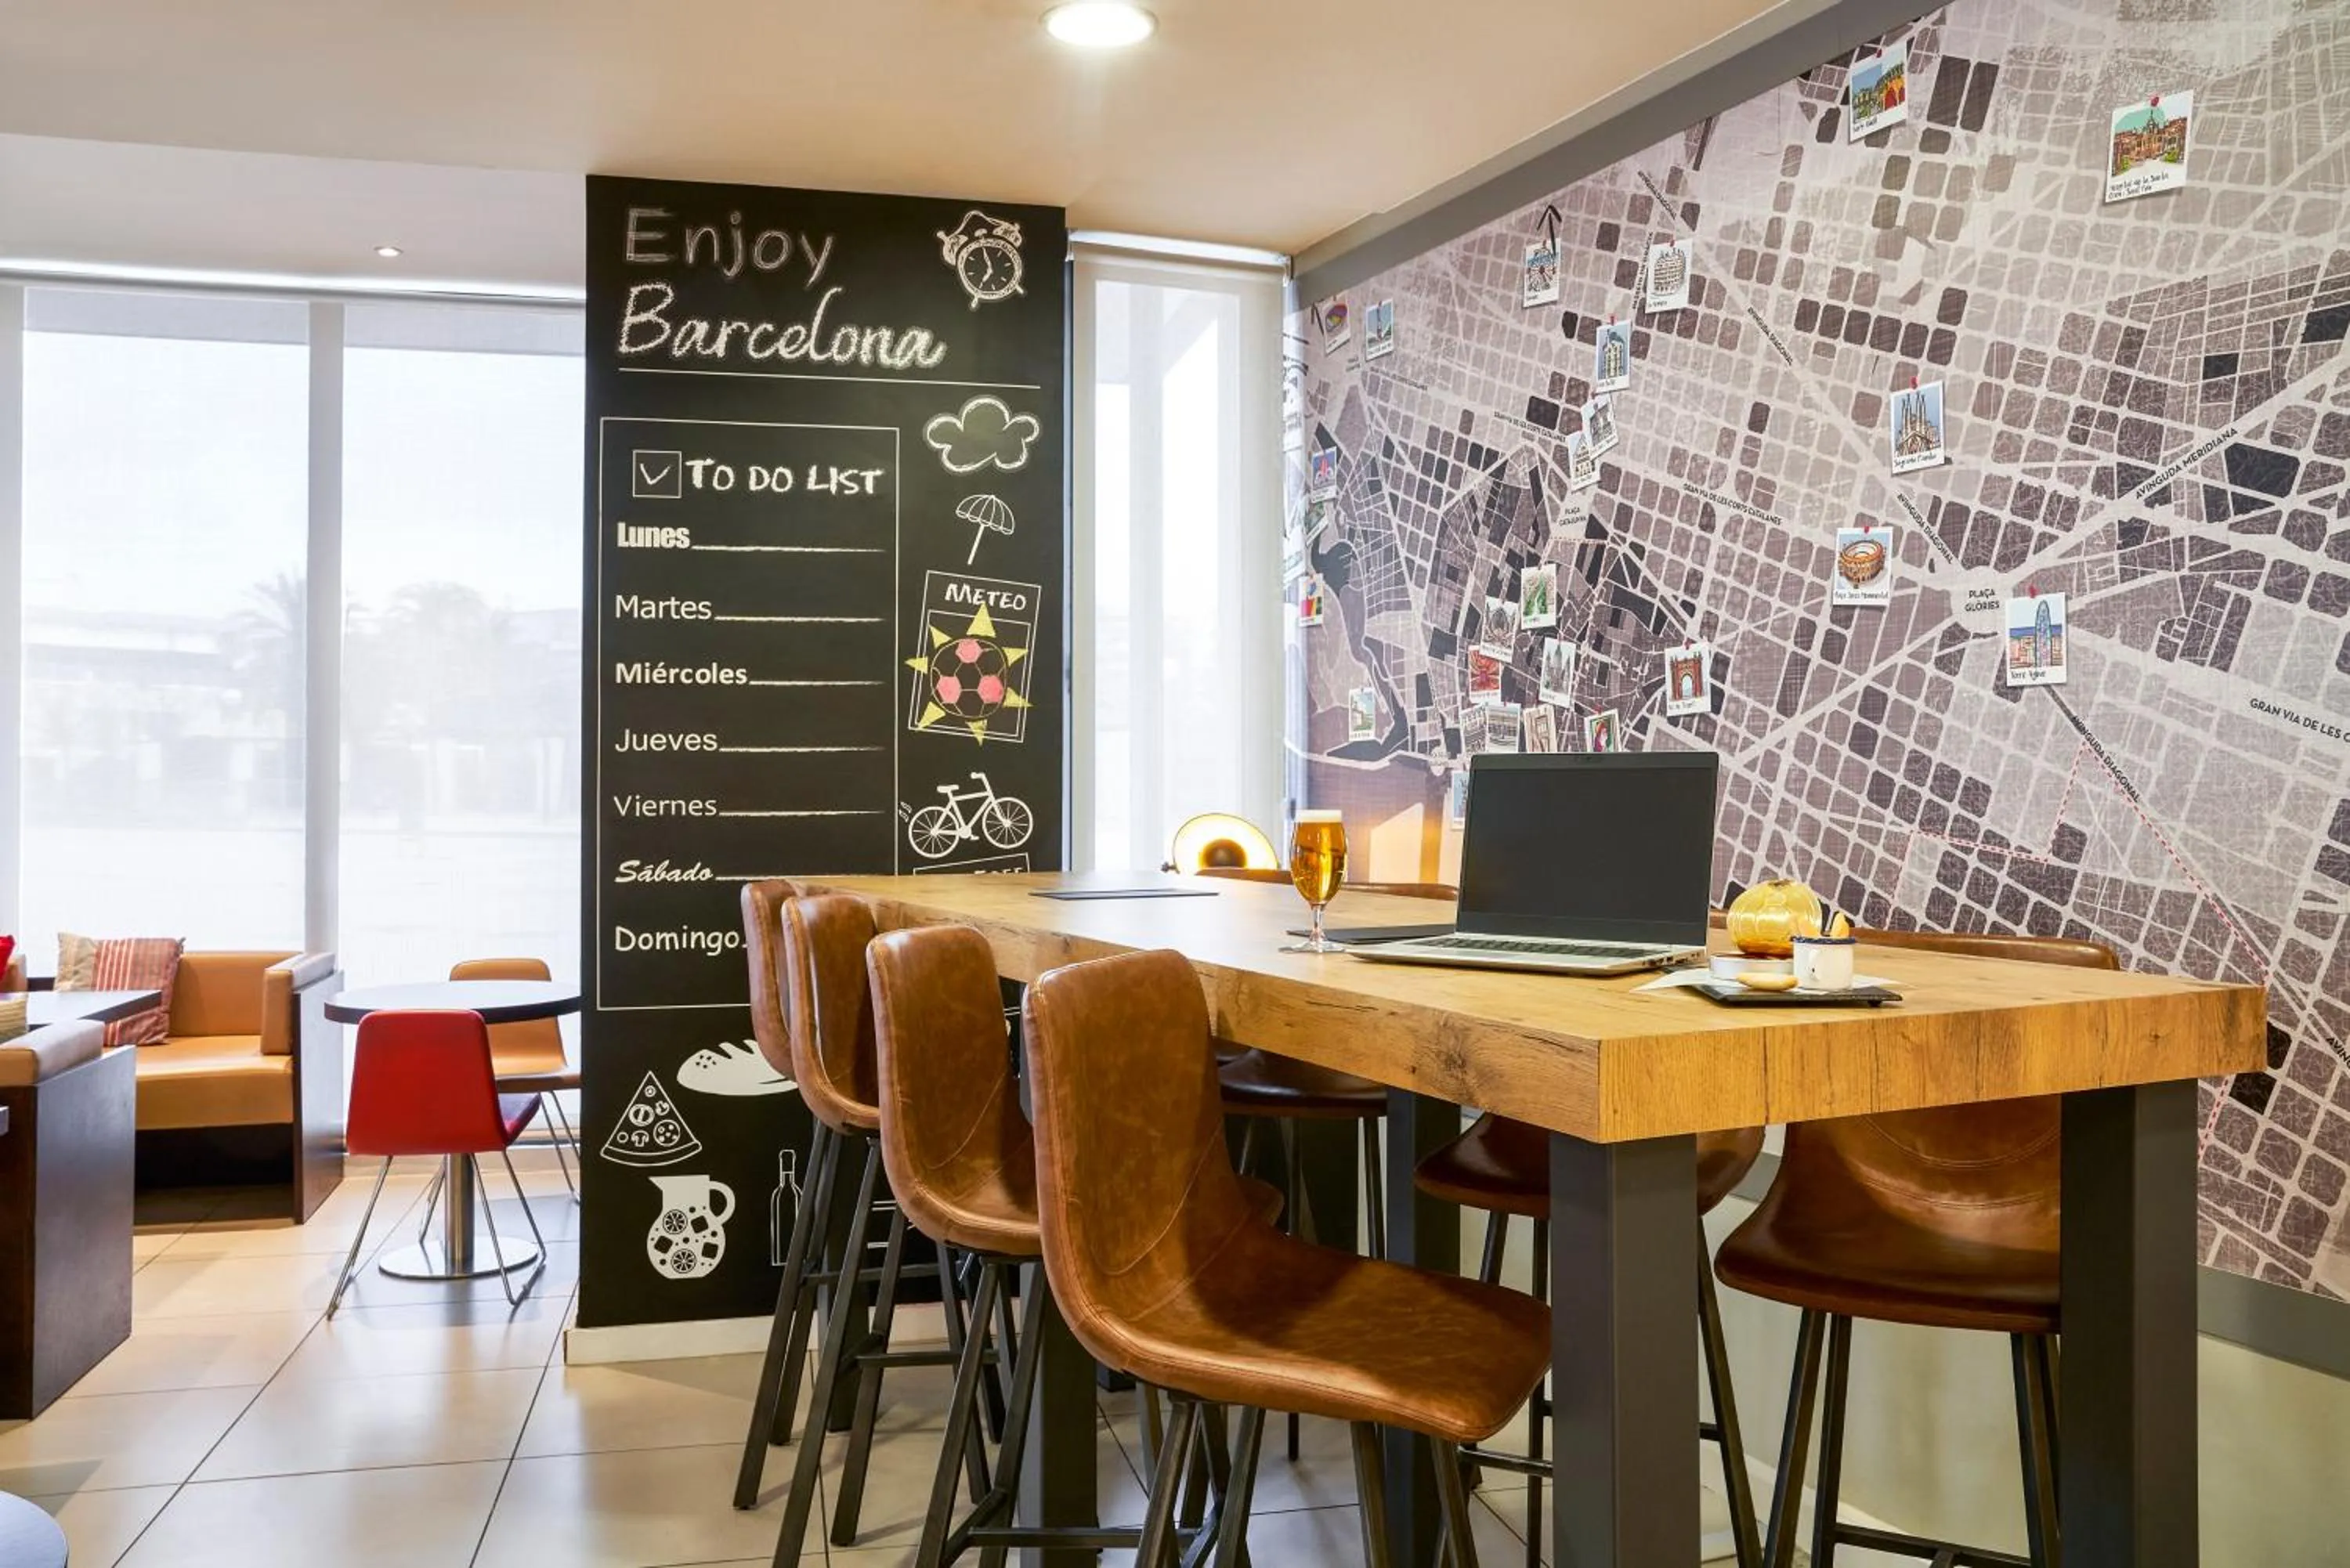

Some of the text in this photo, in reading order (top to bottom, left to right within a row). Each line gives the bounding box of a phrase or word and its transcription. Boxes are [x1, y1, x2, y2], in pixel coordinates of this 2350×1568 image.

[627, 208, 834, 287] Enjoy
[618, 282, 947, 369] Barcelona
[685, 457, 885, 496] TO DO LIST
[2135, 427, 2238, 500] AVINGUDA MERIDIANA
[617, 522, 690, 548] Lunes
[616, 594, 712, 620] Martes
[945, 582, 1027, 611] METEO
[1969, 588, 1995, 598] PLAÇA
[616, 662, 747, 685] Miércoles
[2249, 698, 2281, 715] GRAN
[2283, 710, 2301, 724] VIA
[2303, 717, 2319, 731] DE
[2319, 724, 2341, 739] LES
[615, 728, 718, 753] Jueves
[2103, 755, 2140, 804] DIAGONAL
[613, 796, 717, 817] Viernes
[615, 860, 714, 883] Sábado
[615, 926, 739, 956] Domingo
